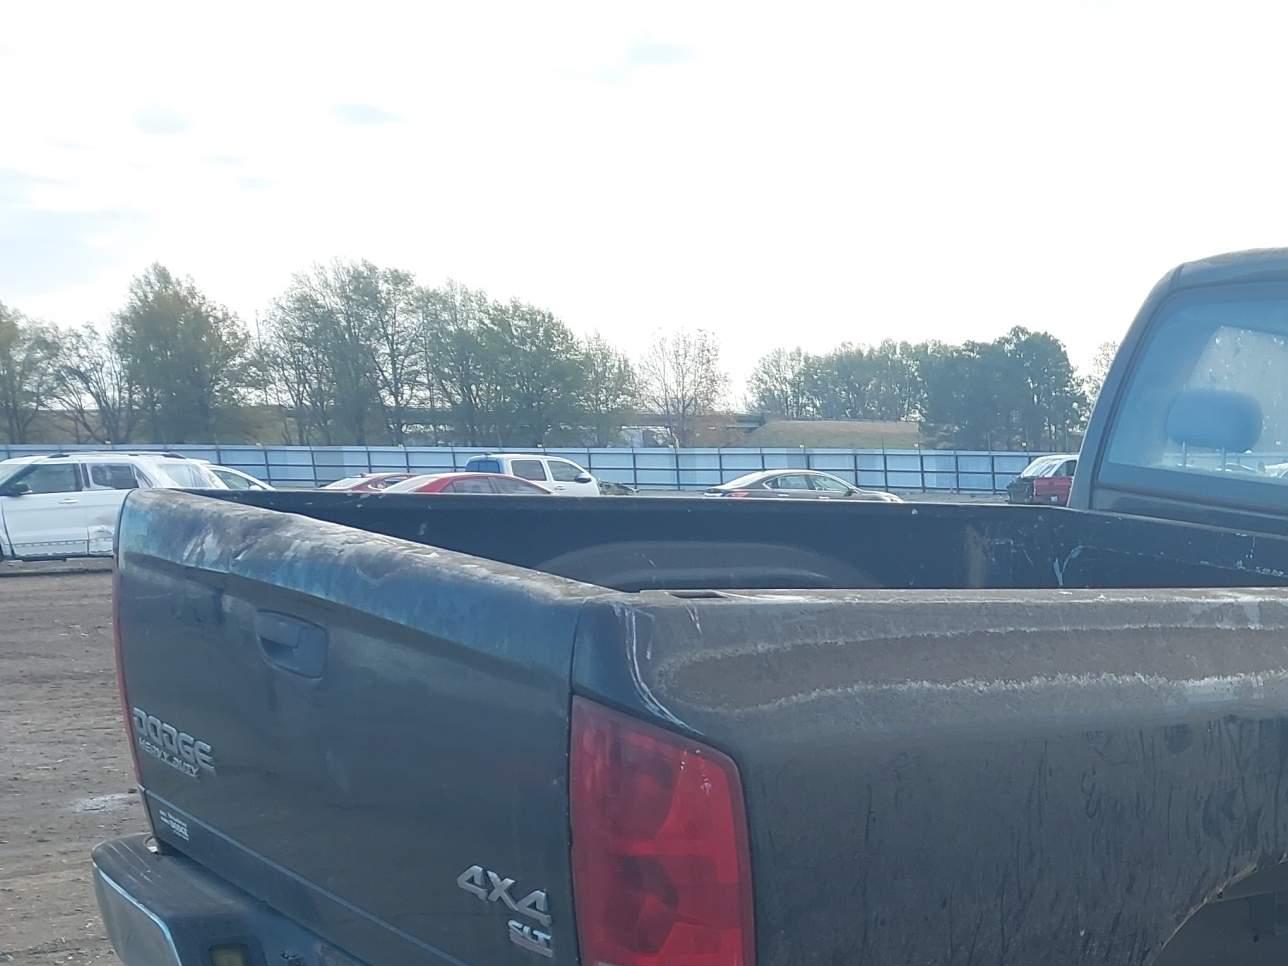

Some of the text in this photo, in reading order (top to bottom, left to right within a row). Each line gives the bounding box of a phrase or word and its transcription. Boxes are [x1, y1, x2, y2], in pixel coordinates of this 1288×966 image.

[133, 706, 215, 770] DODGE
[457, 865, 552, 928] 4X4
[508, 919, 552, 953] SLT
